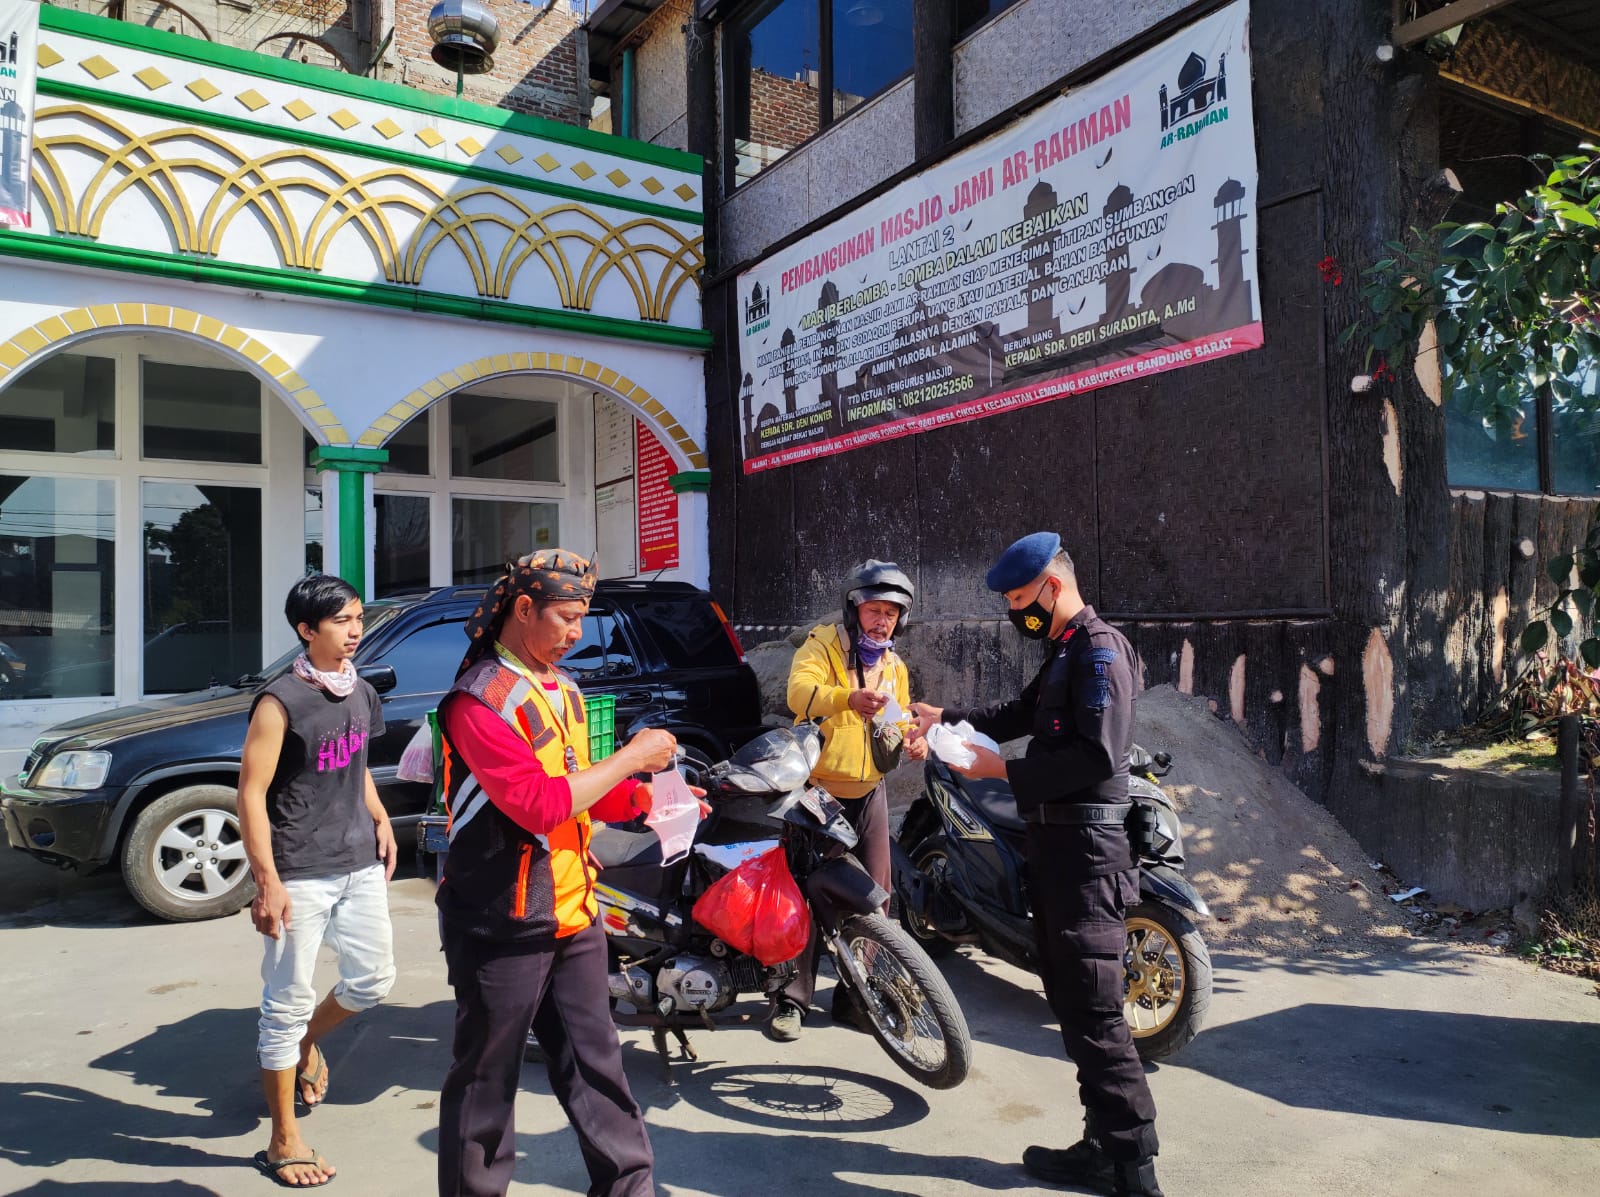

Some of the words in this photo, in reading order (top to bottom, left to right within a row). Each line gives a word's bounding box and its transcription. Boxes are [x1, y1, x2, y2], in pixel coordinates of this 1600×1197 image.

[1161, 105, 1228, 147] AR-RAHMAN
[781, 228, 875, 294] PEMBANGUNAN
[881, 193, 942, 246] MASJID
[948, 168, 993, 214] JAMI
[1002, 95, 1131, 189] AR-RAHMAN
[798, 320, 852, 349] PEMBANGUNAN
[853, 307, 882, 328] MASJID
[883, 298, 904, 317] JAMI
[906, 276, 961, 307] AR-RAHMAN
[962, 264, 988, 286] SIAP
[990, 240, 1050, 275] MENERIMA
[1053, 217, 1103, 250] TITIPAN
[1105, 176, 1194, 228] SUMBANGAN
[801, 306, 827, 330] MARI
[828, 280, 888, 319] BERLOMBA
[898, 256, 944, 290] LOMBA
[946, 233, 997, 270] DALAM
[1001, 193, 1088, 247] KEBAIKAN
[889, 230, 939, 270] LANTAI
[942, 225, 955, 248] 2
[811, 355, 847, 378] MUDAHAN
[847, 346, 874, 366] ALLAH
[875, 324, 939, 355] MEMBALASNYA
[942, 308, 983, 332] DENGAN
[986, 292, 1028, 317] PAHALA
[1030, 280, 1055, 302] DAN
[1059, 254, 1129, 292] GANJARAN
[812, 343, 834, 361] INFAQ
[835, 338, 850, 353] DAN
[851, 322, 890, 347] SODAQOH
[891, 308, 925, 332] BERUPA
[927, 297, 956, 319] UANG
[956, 286, 984, 308] ATAU
[986, 265, 1041, 296] MATERIAL
[1045, 247, 1086, 275] BAHAN
[1089, 214, 1167, 257] BANGUNAN
[871, 358, 895, 375] AMIIN
[897, 344, 936, 367] YAROBAL
[939, 329, 979, 353] ALAMIN.
[1003, 336, 1030, 352] BERUPA
[1032, 329, 1052, 342] UANG
[1004, 345, 1041, 367] KEPADA
[1044, 337, 1067, 355] SDR.
[1070, 328, 1095, 347] DEDI
[1100, 308, 1160, 337] SURADITA,
[1163, 296, 1196, 319] A.Md
[847, 393, 860, 404] TTD
[860, 387, 882, 401] KETUA
[886, 373, 923, 393] PENGURUS
[925, 365, 952, 381] MASJID
[848, 396, 896, 421] INFORMASI
[904, 375, 973, 405] 082120252566
[936, 411, 954, 423] DESA
[956, 404, 982, 417] CIKOLE
[985, 391, 1032, 410] KECAMATAN
[1035, 380, 1075, 398] LEMBANG
[1078, 364, 1134, 387] KABUPATEN
[1137, 349, 1191, 372] BANDUNG
[1194, 338, 1232, 357] BARAT
[781, 421, 794, 432] SDR.
[809, 409, 832, 424] KONTER
